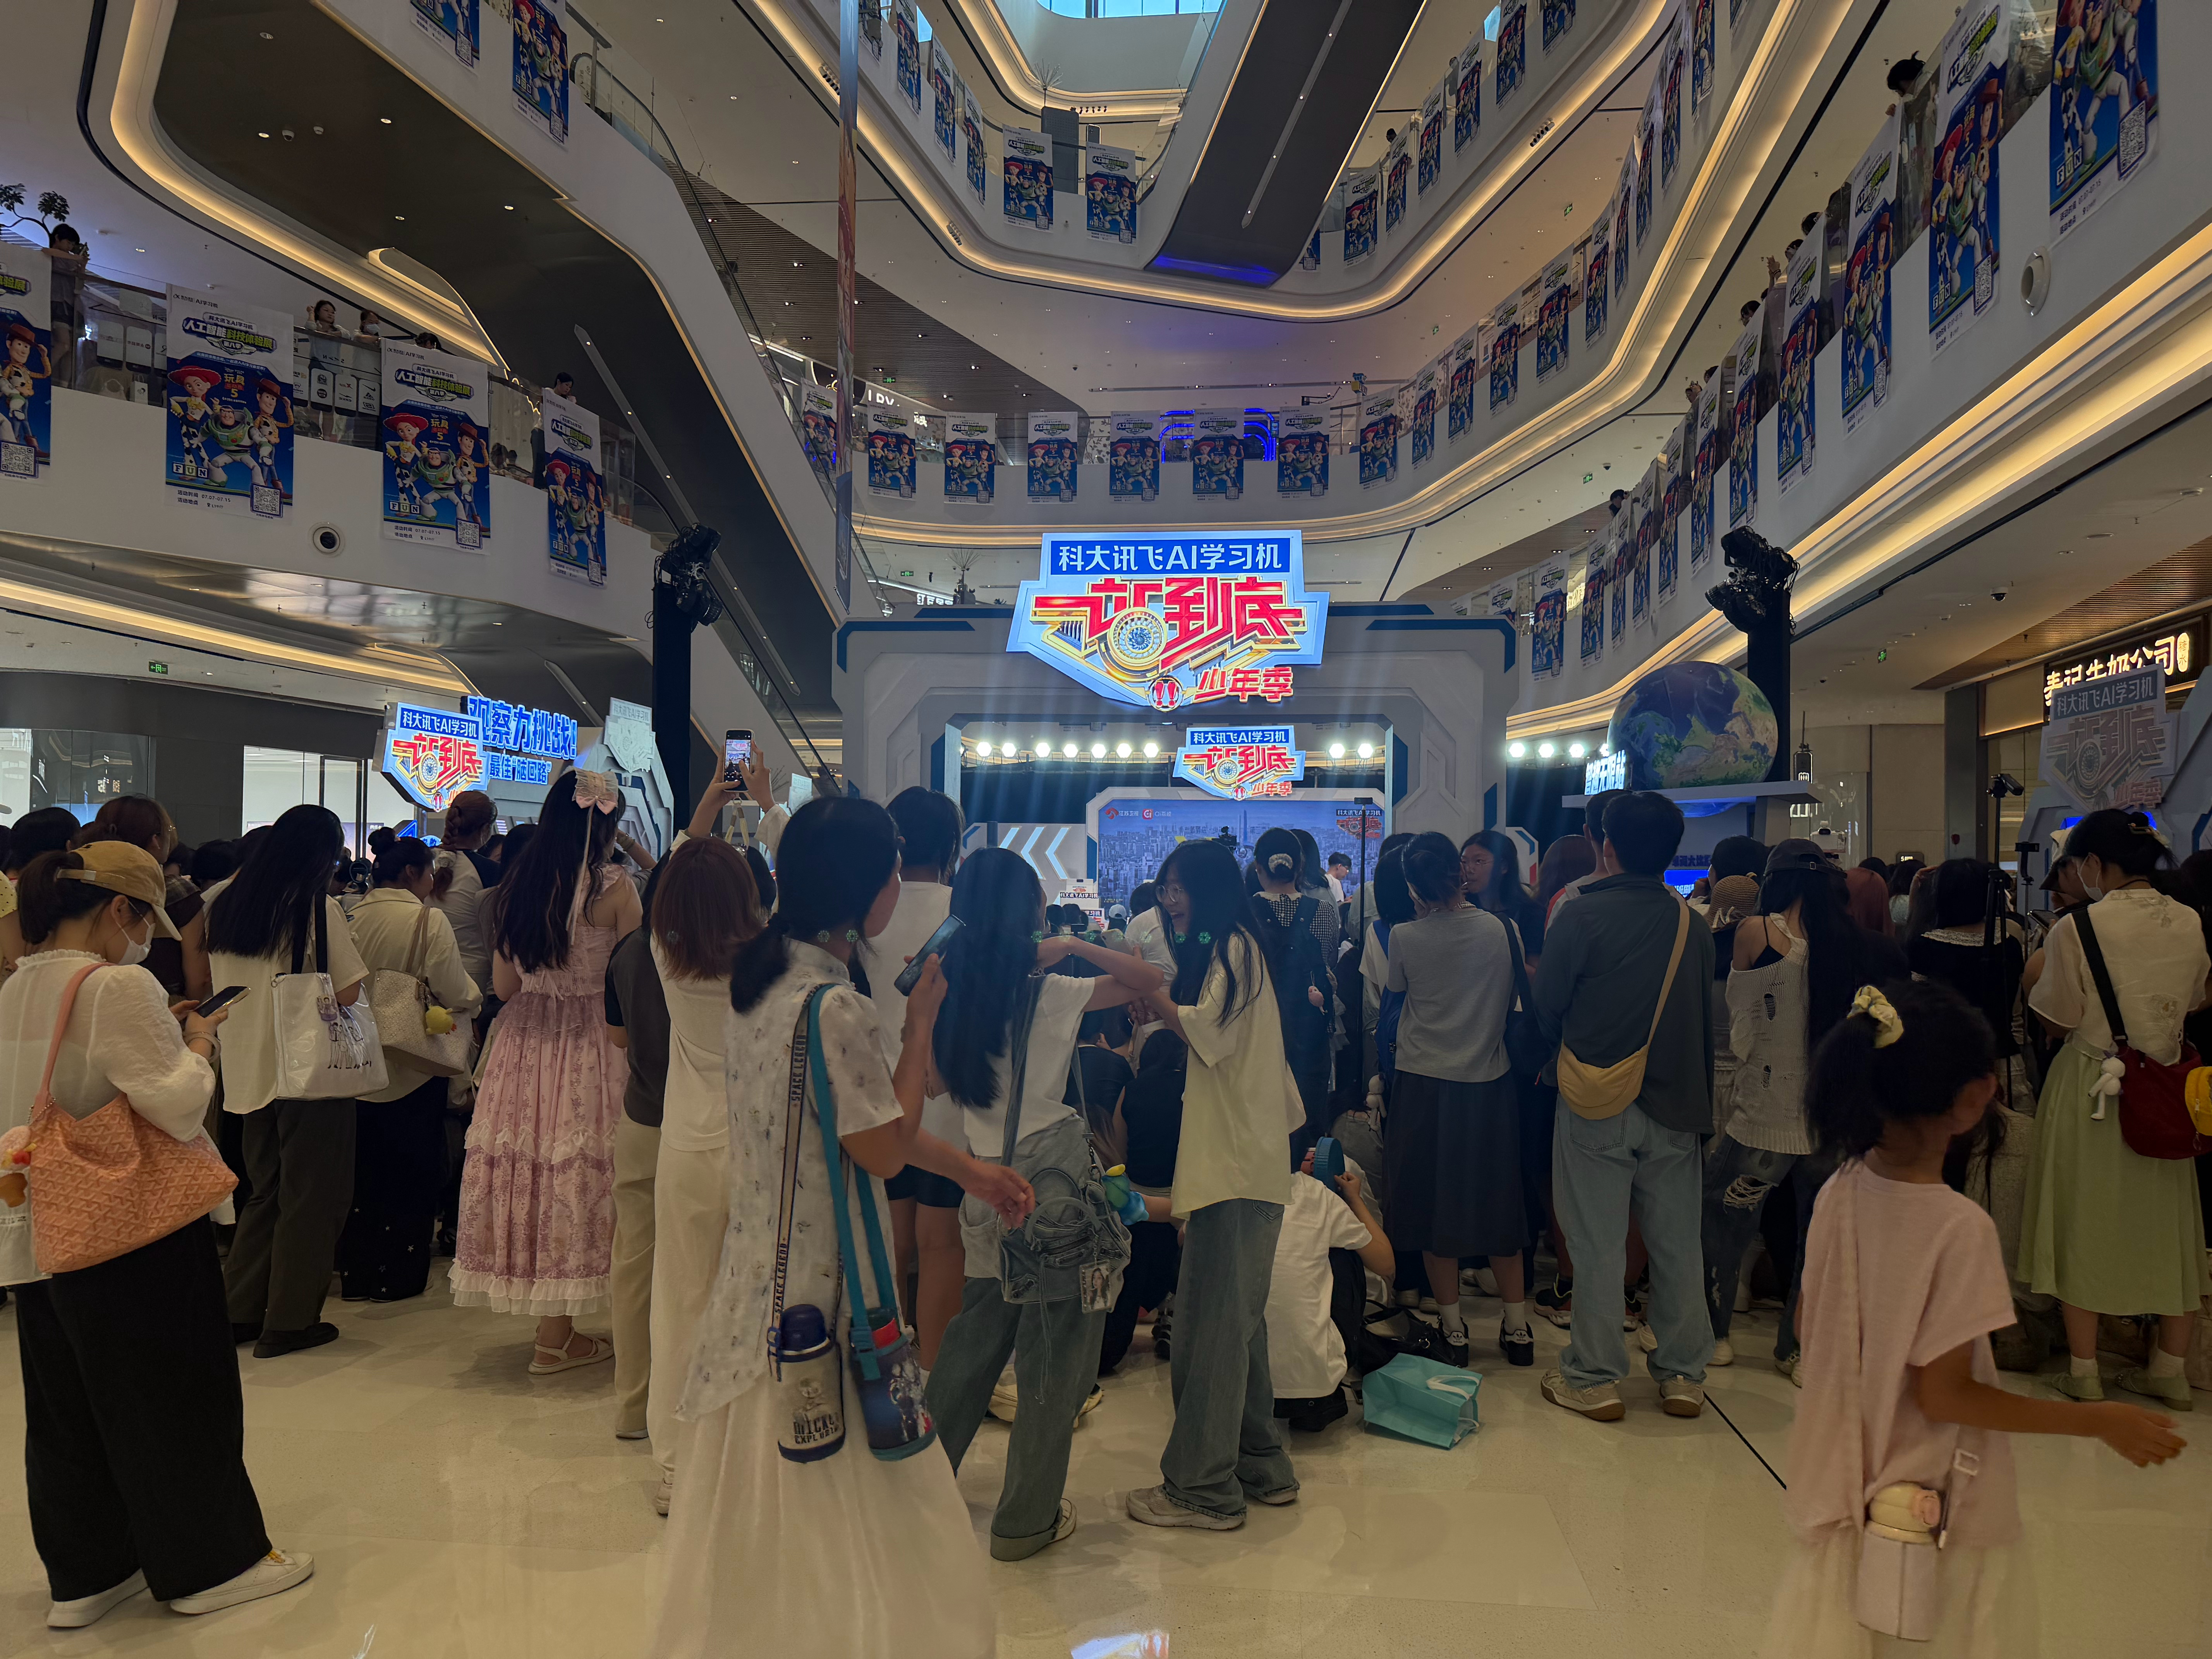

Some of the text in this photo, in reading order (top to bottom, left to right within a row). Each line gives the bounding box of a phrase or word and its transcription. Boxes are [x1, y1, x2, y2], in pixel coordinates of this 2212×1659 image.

[184, 319, 273, 350] 人工智能科技体验展
[223, 373, 246, 386] 玩具
[230, 389, 239, 398] 5
[430, 419, 449, 429] 玩具
[437, 432, 444, 441] 5
[175, 465, 206, 476] FUN
[202, 494, 231, 503] 07.07-07.15
[392, 503, 419, 513] FUN
[1058, 542, 1283, 572] 科大讯飞AI学习机
[1031, 576, 1308, 665] 一站到底
[1195, 666, 1294, 703] 少年季
[2057, 676, 2154, 717] 科大讯飞AI学习机
[402, 710, 478, 738] 科大讯飞AI学习机
[468, 696, 577, 760] 观察力挑战!
[1193, 731, 1286, 744] 科大讯飞AI学习机
[2045, 705, 2166, 786] 一站到底
[392, 733, 483, 788] 一站到底
[1183, 745, 1296, 785] 一站到底
[1251, 781, 1293, 797] 少年季
